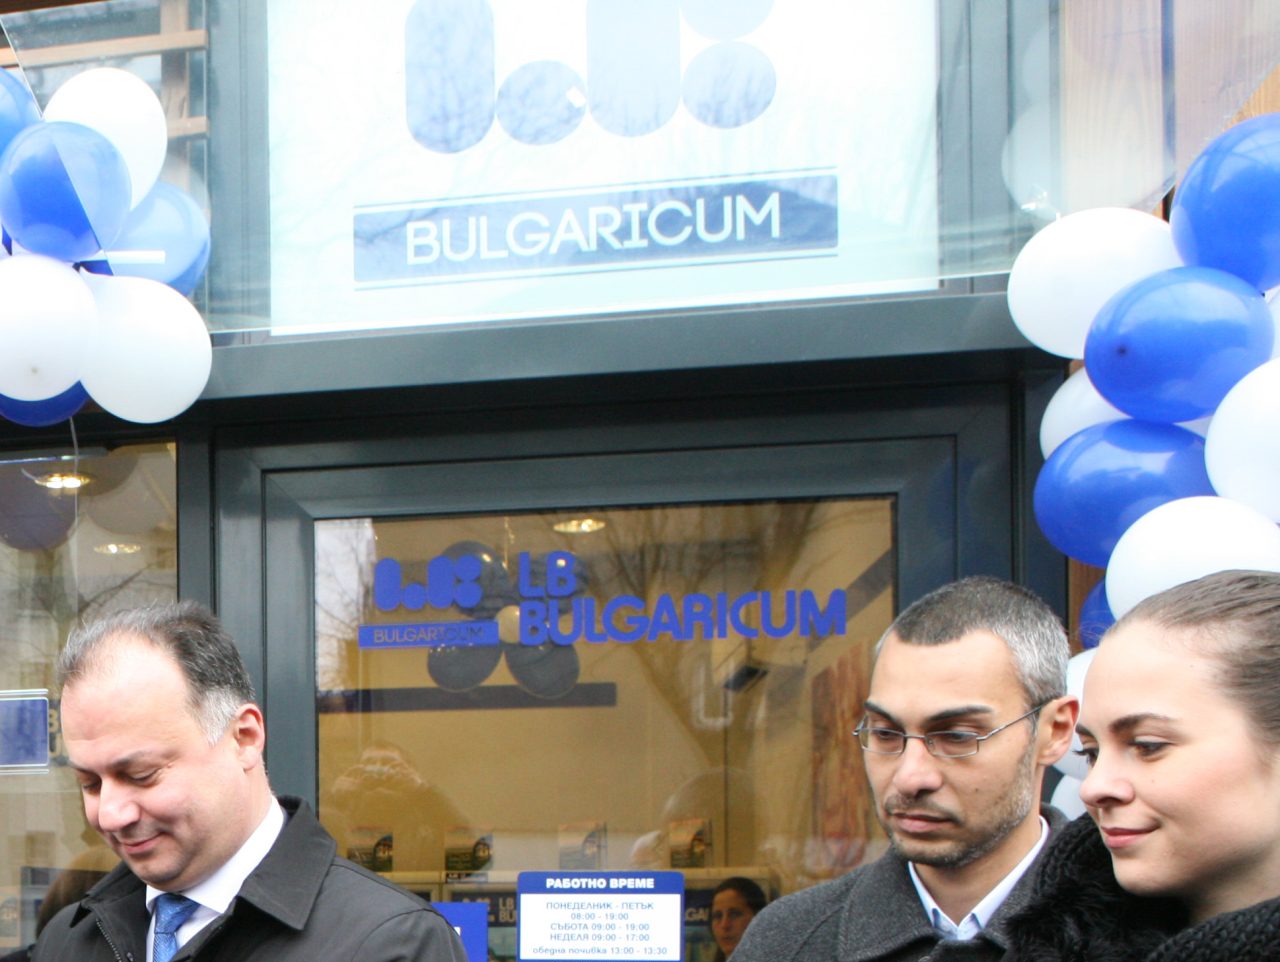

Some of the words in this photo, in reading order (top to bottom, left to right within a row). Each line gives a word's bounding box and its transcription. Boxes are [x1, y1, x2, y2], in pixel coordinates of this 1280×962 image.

[407, 192, 780, 265] BULGARICUM
[520, 551, 577, 598] LB
[520, 589, 847, 646] BULGARICUM
[374, 626, 484, 643] BULGARICUM
[546, 878, 607, 888] РАБОТНО
[609, 878, 655, 888] ВРЕМЕ
[546, 902, 613, 910] ПОНЕДЕЛНИК
[621, 902, 654, 910] ПЕТЪК
[570, 912, 595, 920] 08:00
[605, 912, 629, 920] 19:00
[625, 923, 650, 931] 19:00
[550, 933, 589, 942] НЕДЕЛЯ
[591, 933, 616, 941] 09:00
[625, 933, 650, 941] 17:00
